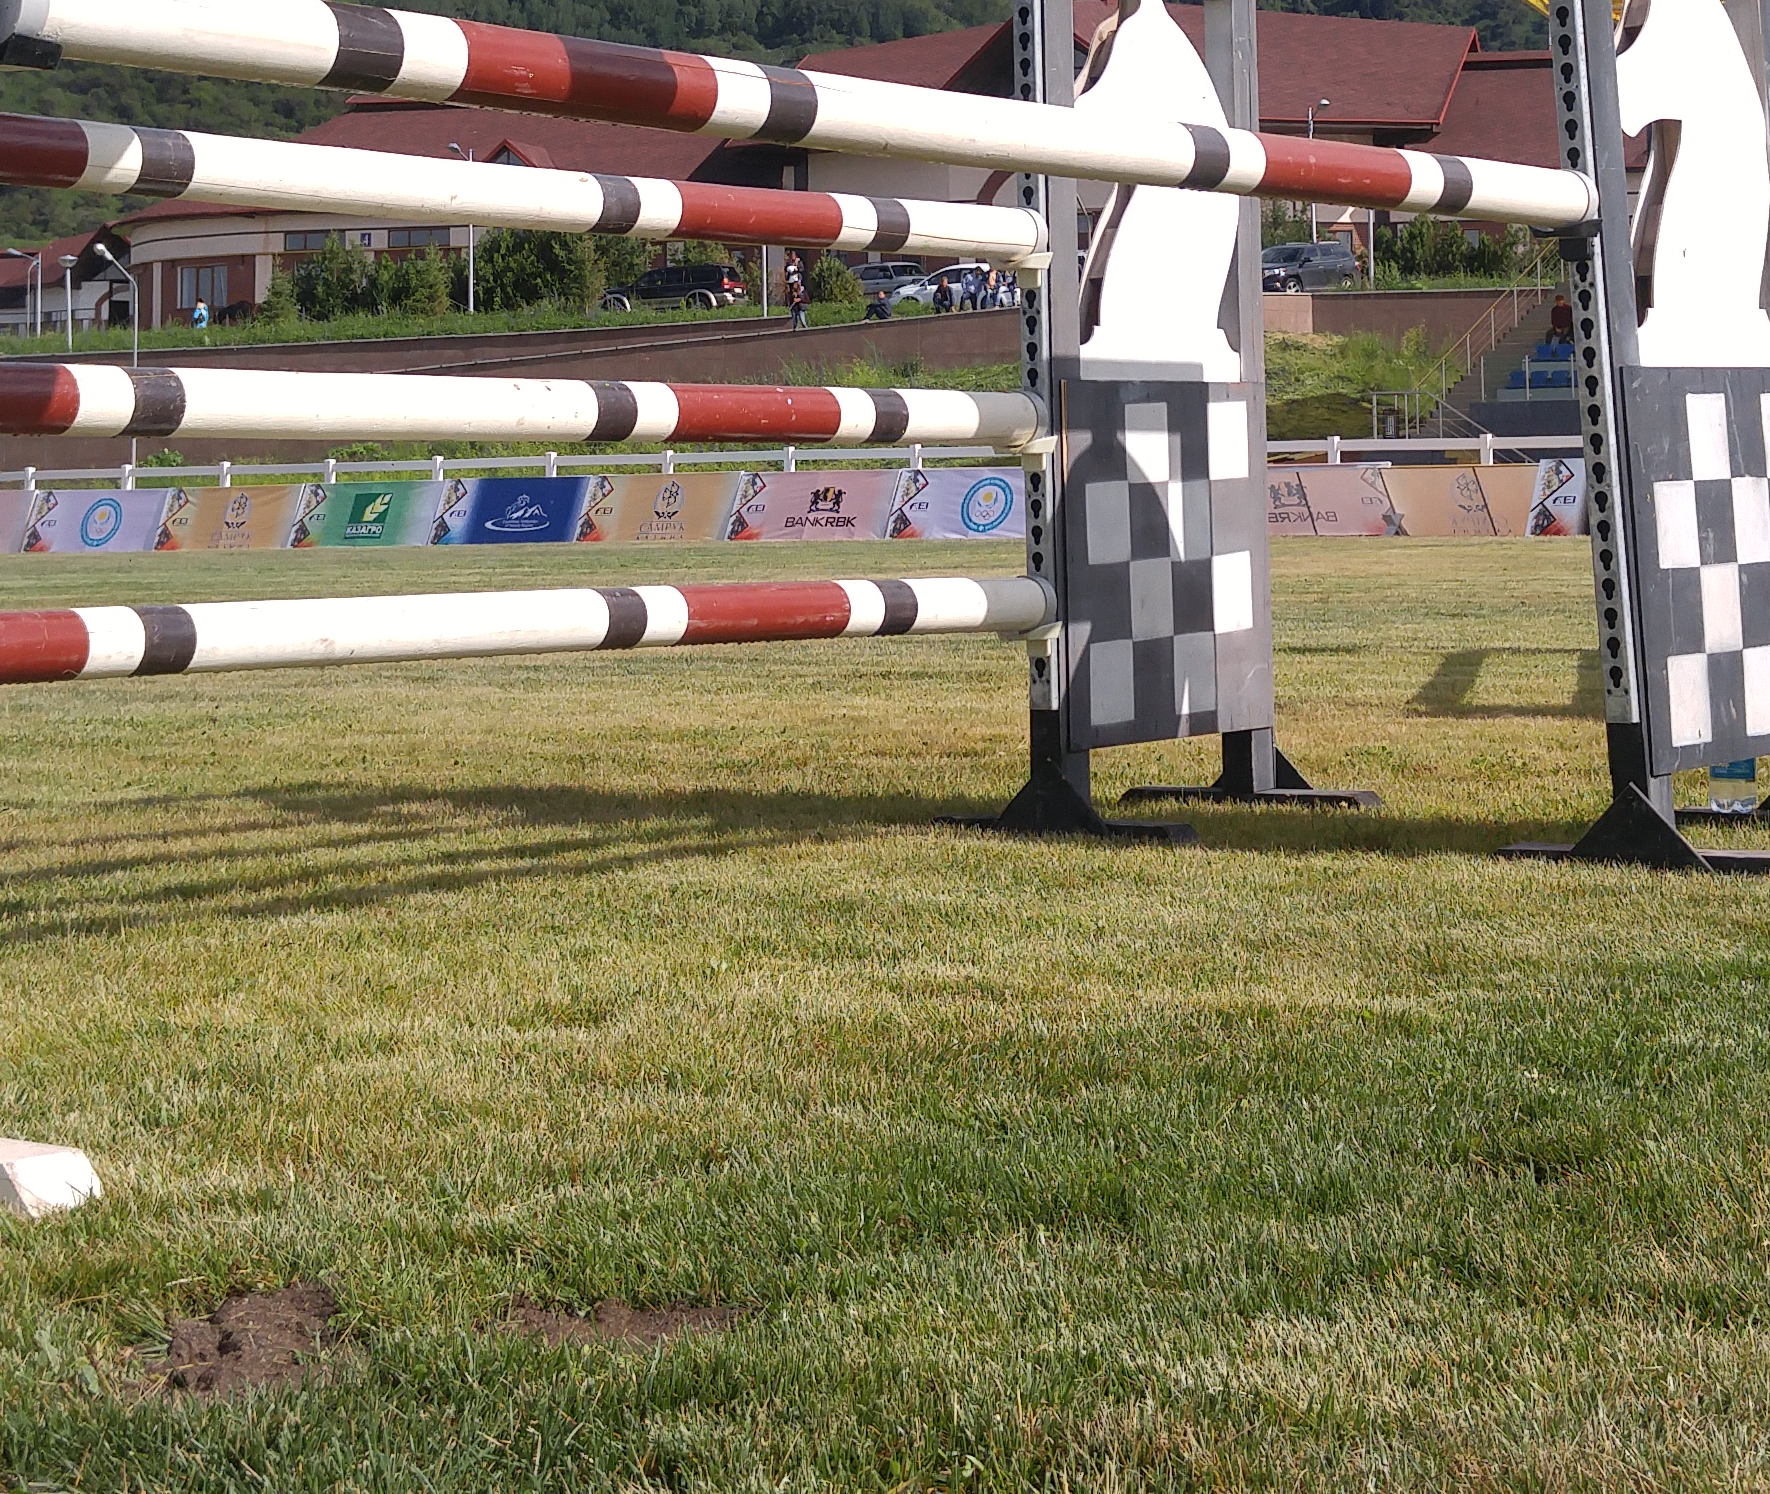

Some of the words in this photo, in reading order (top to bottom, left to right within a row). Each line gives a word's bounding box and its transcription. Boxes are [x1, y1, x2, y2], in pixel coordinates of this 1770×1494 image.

[1552, 495, 1576, 505] FEI
[784, 516, 858, 528] BANKRBK
[345, 525, 383, 535] КАЗАГРО
